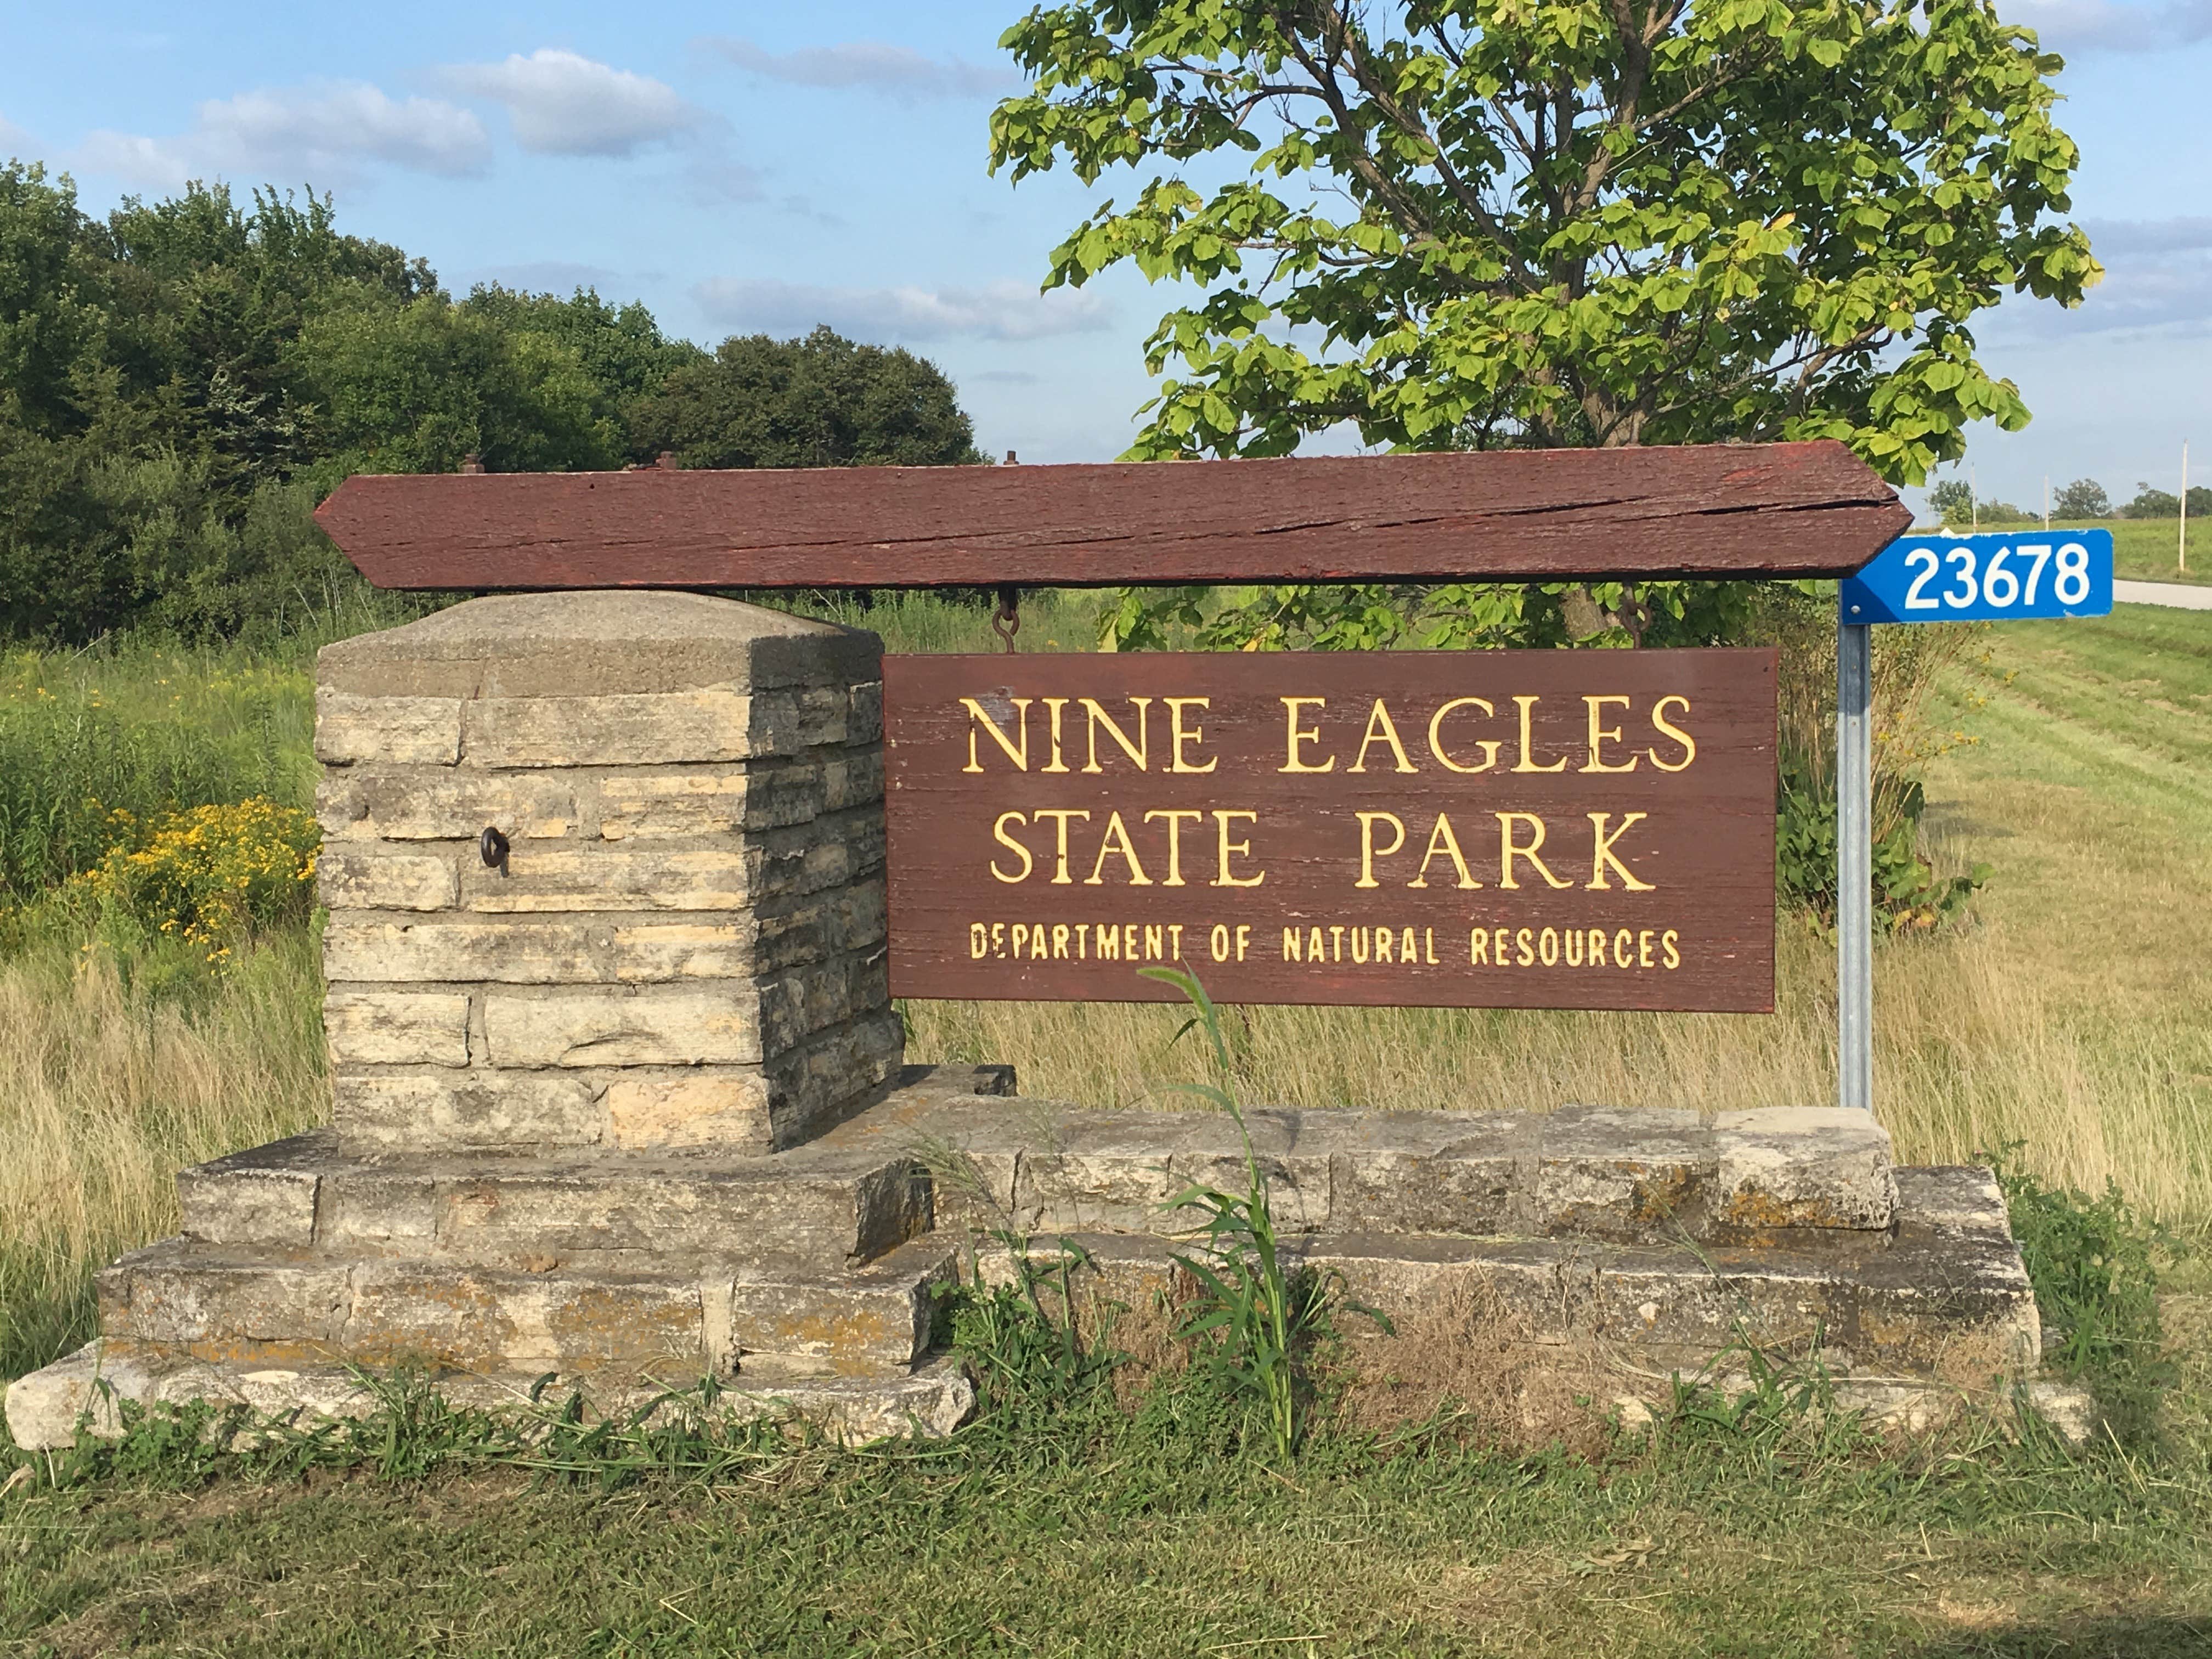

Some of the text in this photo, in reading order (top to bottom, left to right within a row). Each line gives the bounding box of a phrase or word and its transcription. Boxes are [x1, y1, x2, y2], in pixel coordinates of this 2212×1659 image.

[1905, 543, 2090, 609] 23678
[958, 696, 1696, 774] NINE EAGLES
[990, 810, 1657, 891] STATE PARK
[970, 923, 1681, 969] DEPARTMENT OF NATURAL RESOURCES
